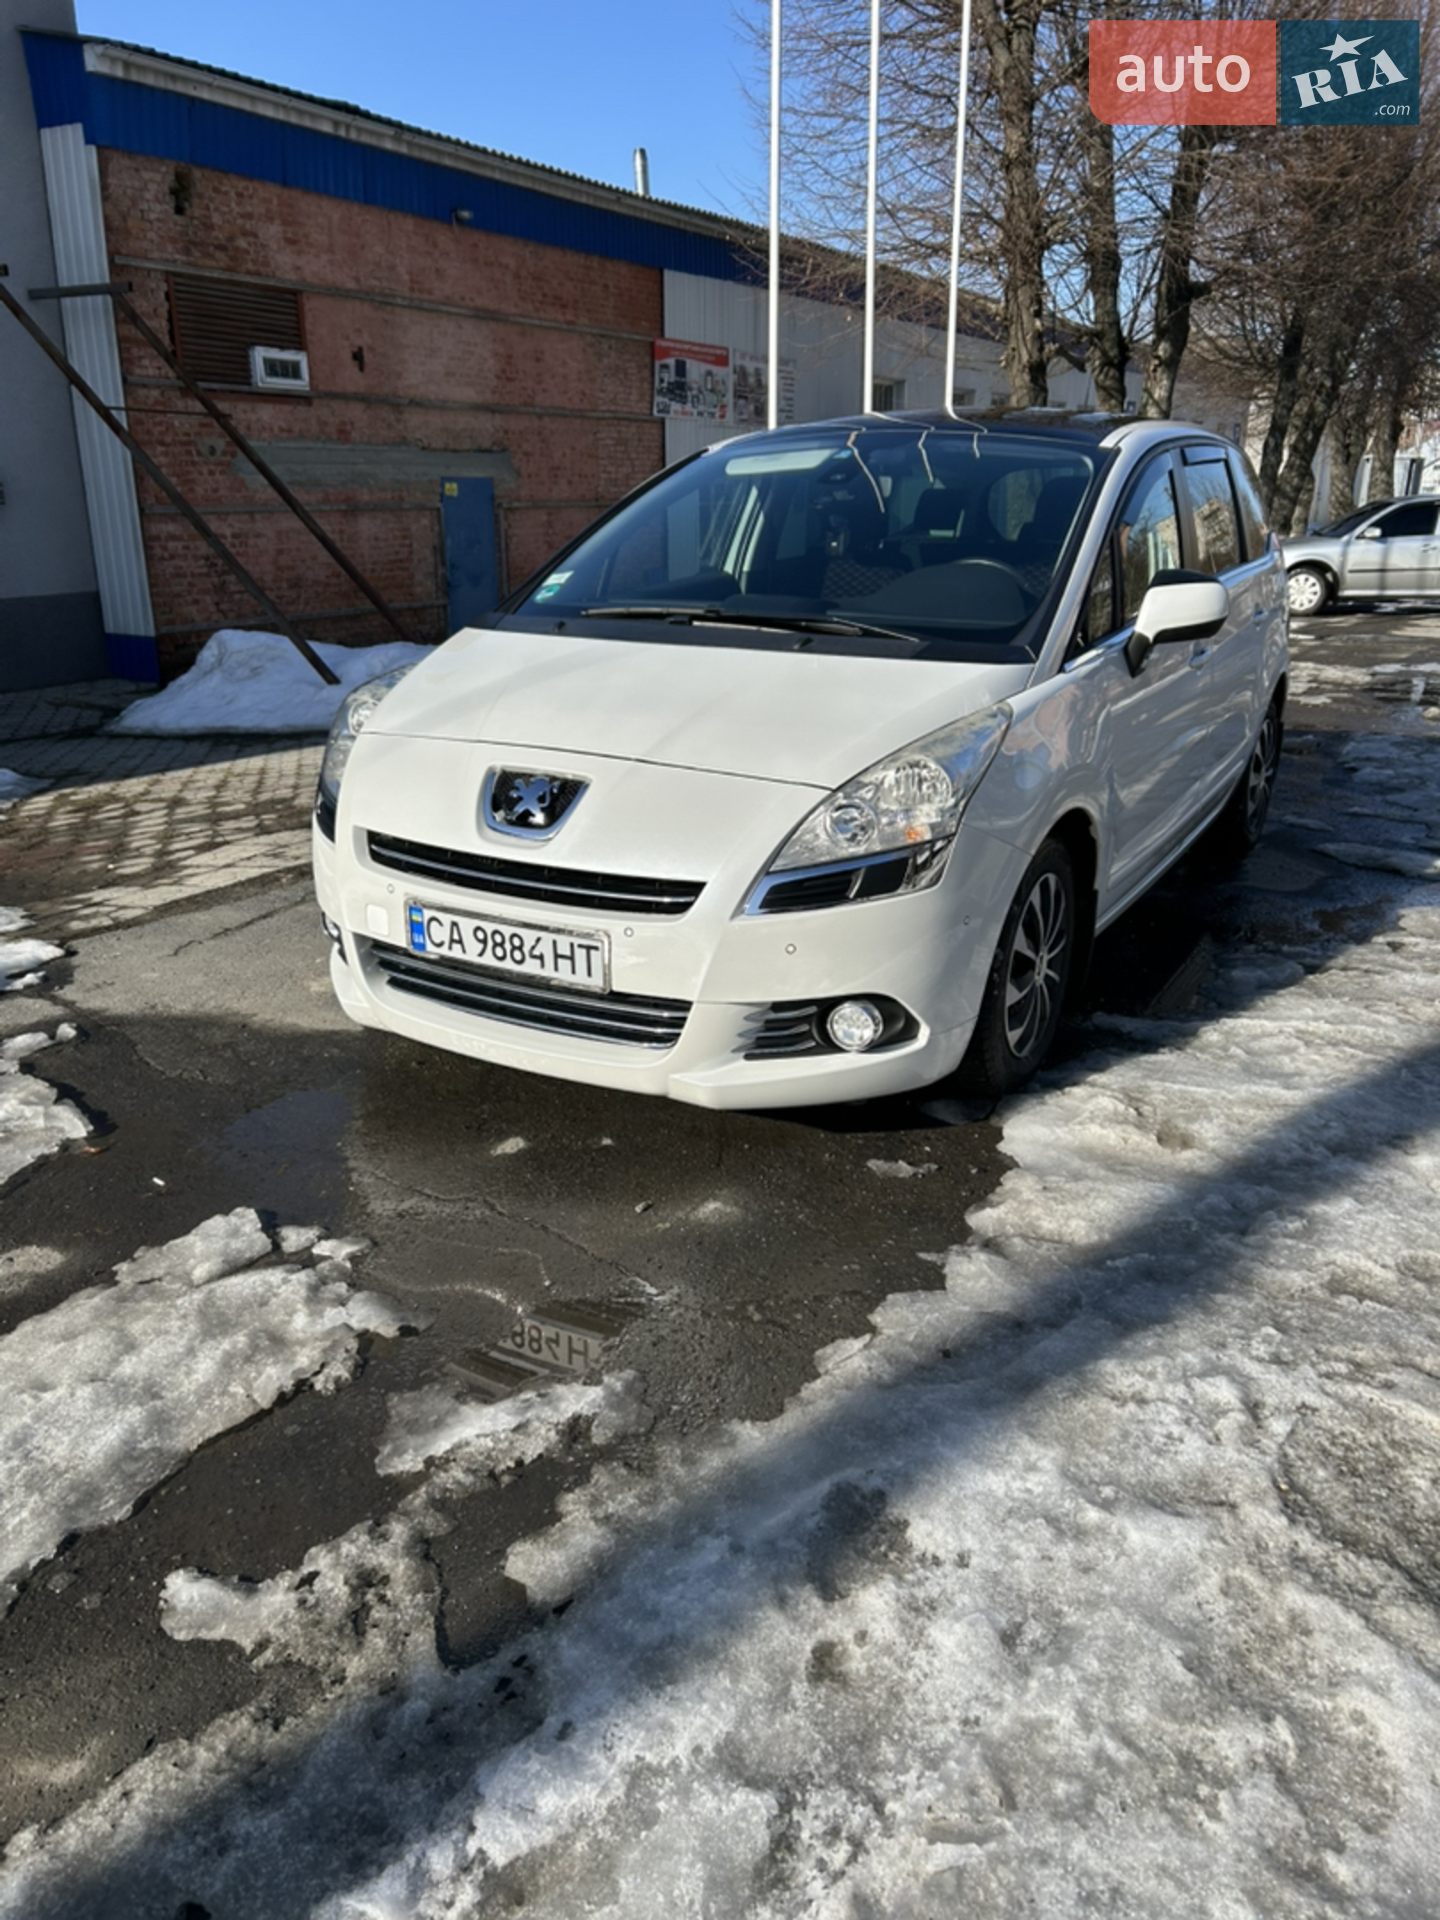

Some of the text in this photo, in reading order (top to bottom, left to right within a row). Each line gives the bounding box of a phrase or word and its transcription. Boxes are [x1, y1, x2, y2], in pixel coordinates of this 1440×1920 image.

[426, 916, 600, 978] CA 9884 HT
